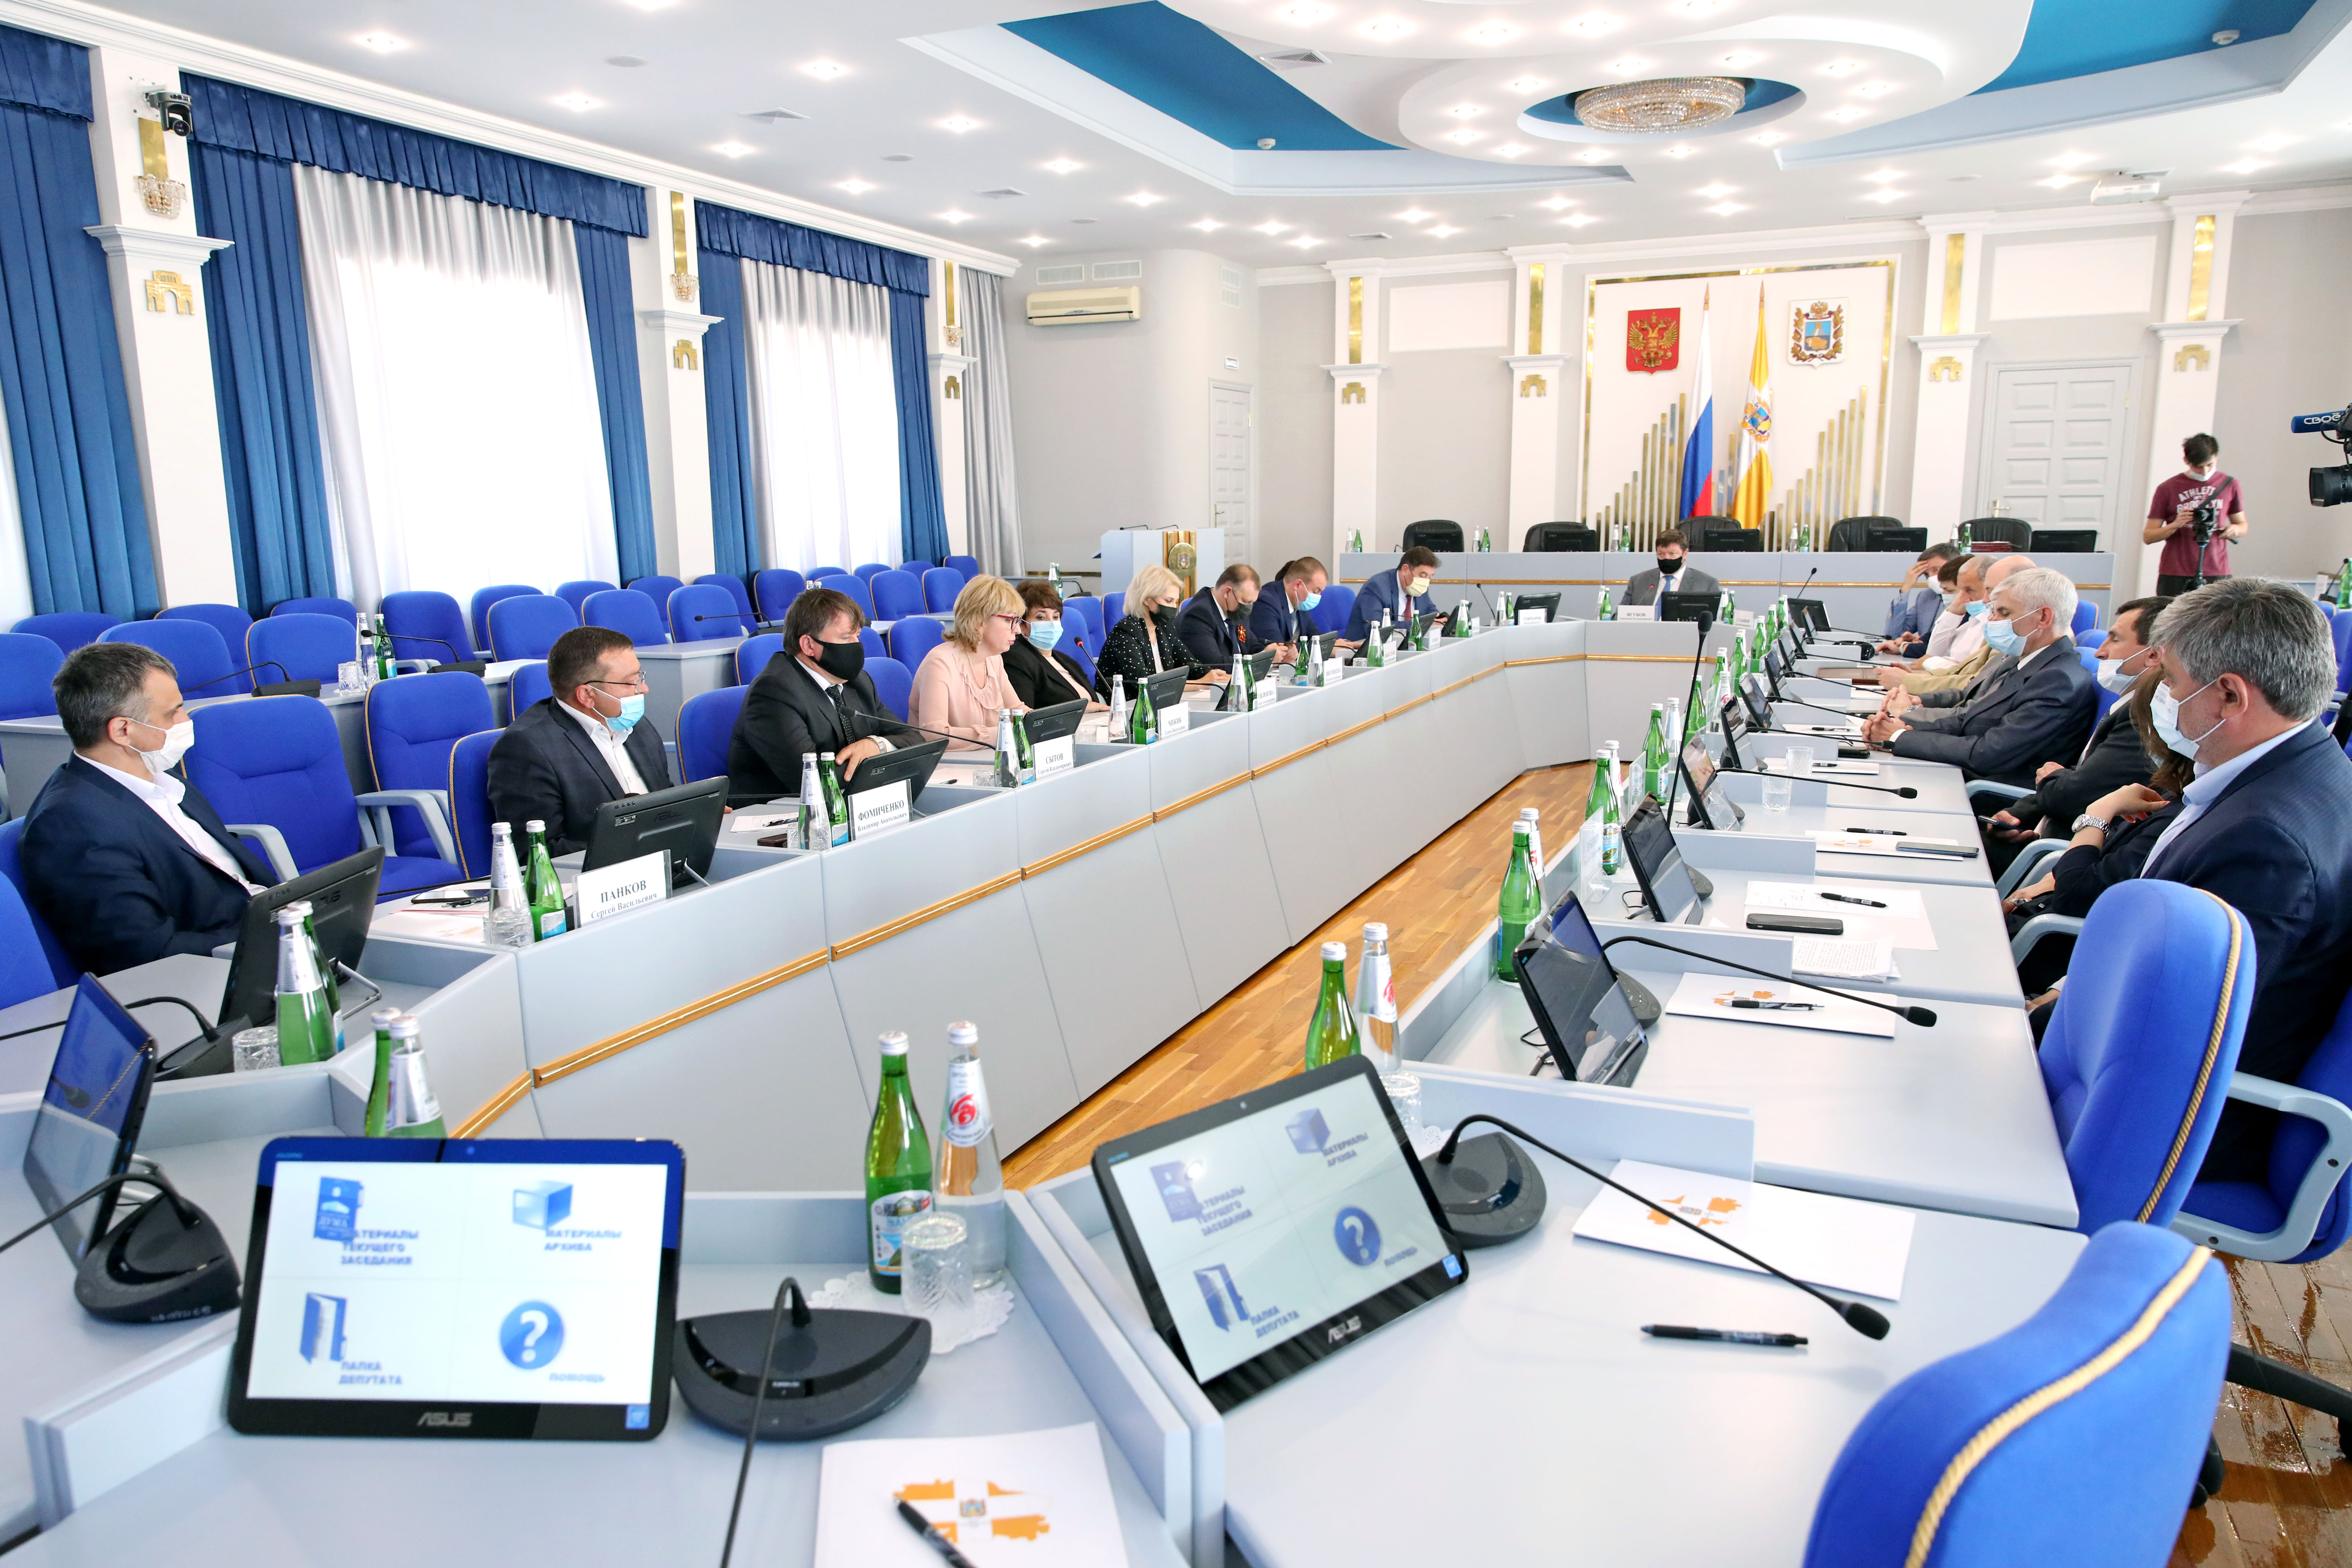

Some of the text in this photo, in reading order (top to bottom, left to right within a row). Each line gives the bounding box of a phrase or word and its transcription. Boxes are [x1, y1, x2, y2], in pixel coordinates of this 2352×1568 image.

[1168, 717, 1182, 726] ЧИЖИК
[1046, 753, 1063, 764] СЫТОВ
[858, 800, 904, 821] ФОМИЧЕНКО
[857, 812, 907, 832] Владимир Анатольевич
[601, 880, 647, 903] ПАНКОВ
[591, 893, 657, 919] Сергей Васильевич
[545, 1229, 622, 1238] МАТЕРИАЛЫ
[341, 1256, 412, 1265] ЗАСЕДАНИЯ
[1328, 1315, 1362, 1344] ASUS
[341, 1361, 382, 1370] ПАПКА
[339, 1374, 403, 1384] ДЕПУТАТА
[417, 1412, 473, 1426] ASUS
